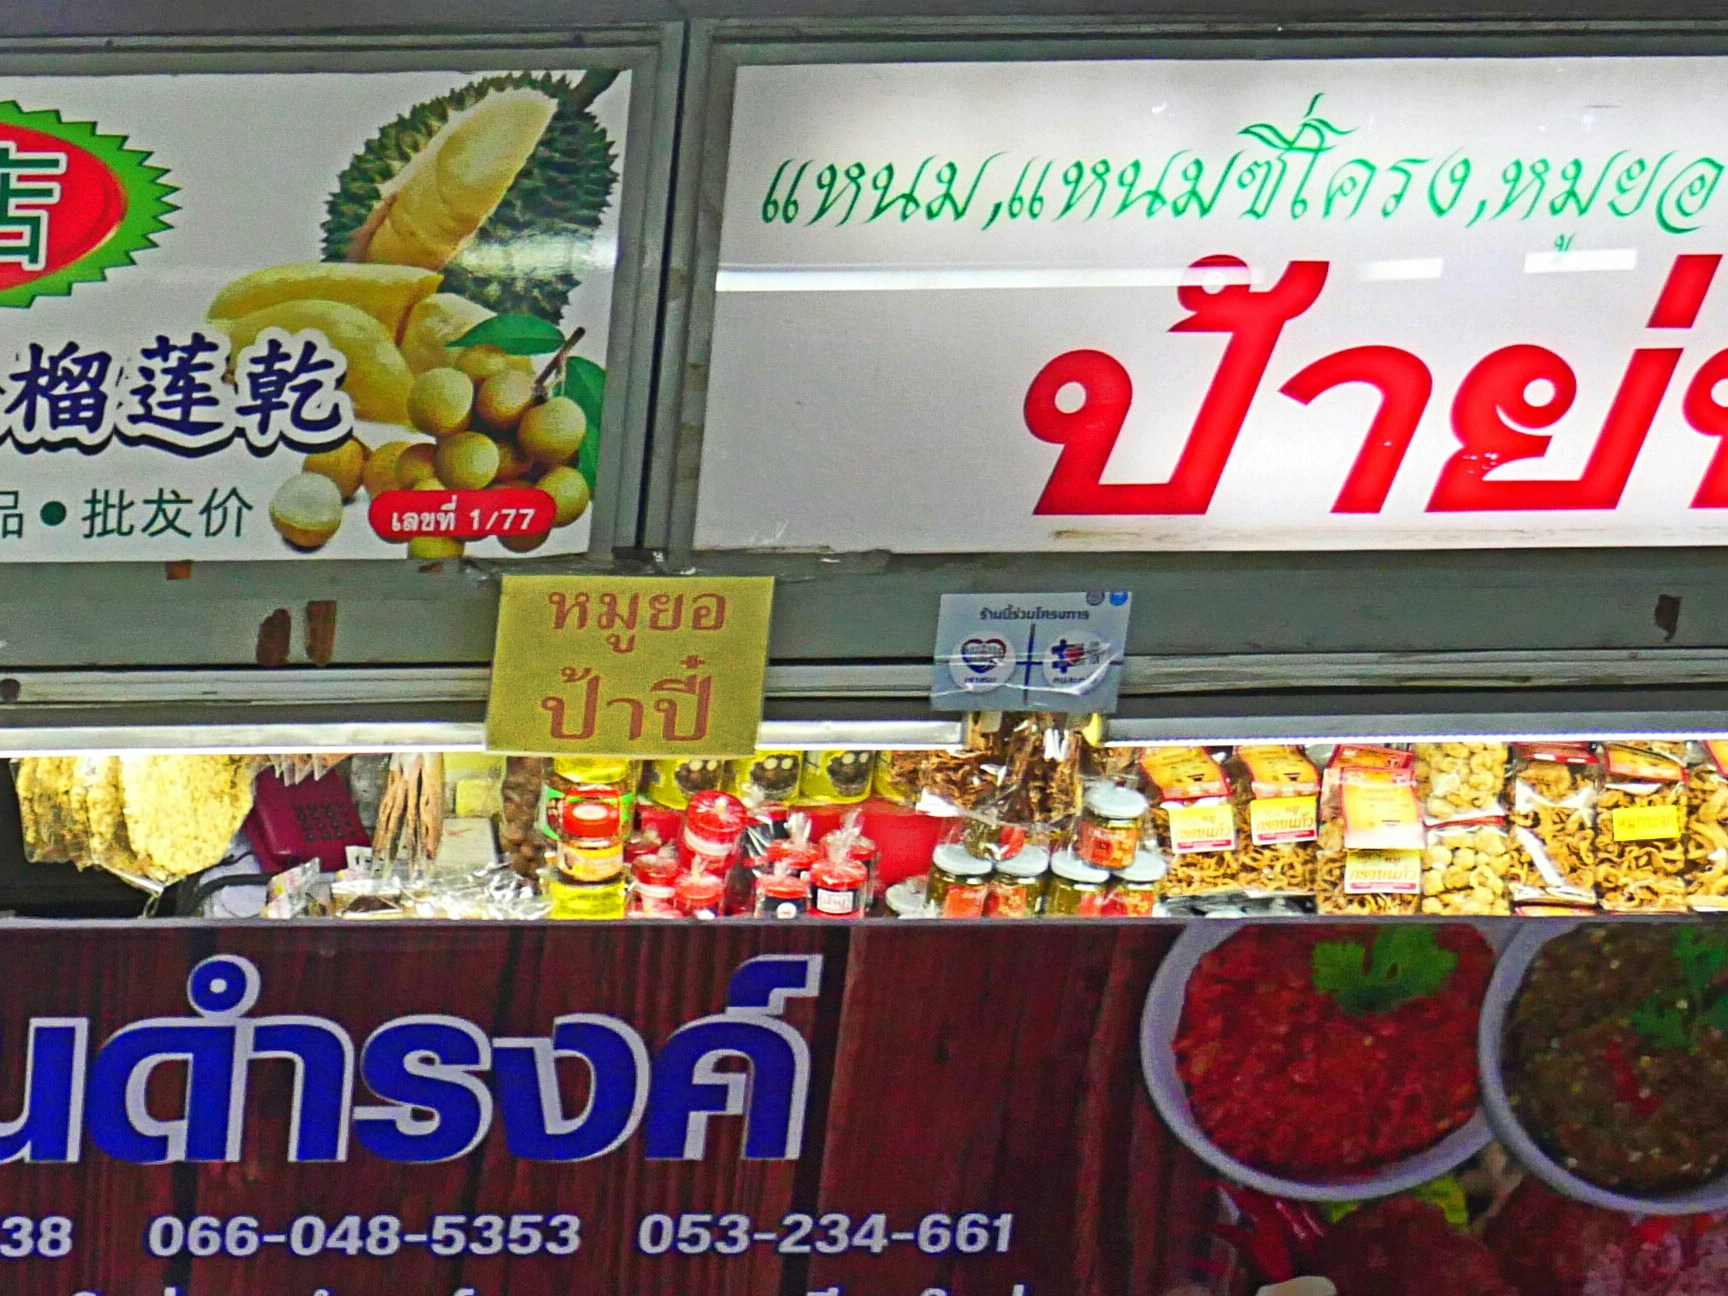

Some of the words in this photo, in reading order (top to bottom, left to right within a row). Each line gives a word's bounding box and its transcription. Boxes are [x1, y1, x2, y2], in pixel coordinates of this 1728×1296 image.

[390, 495, 458, 534] เลขที่
[468, 506, 535, 533] 1/77
[547, 589, 727, 654] หมูยอ
[148, 1212, 584, 1259] 066-048-5353
[637, 1210, 1016, 1257] 053-234-661
